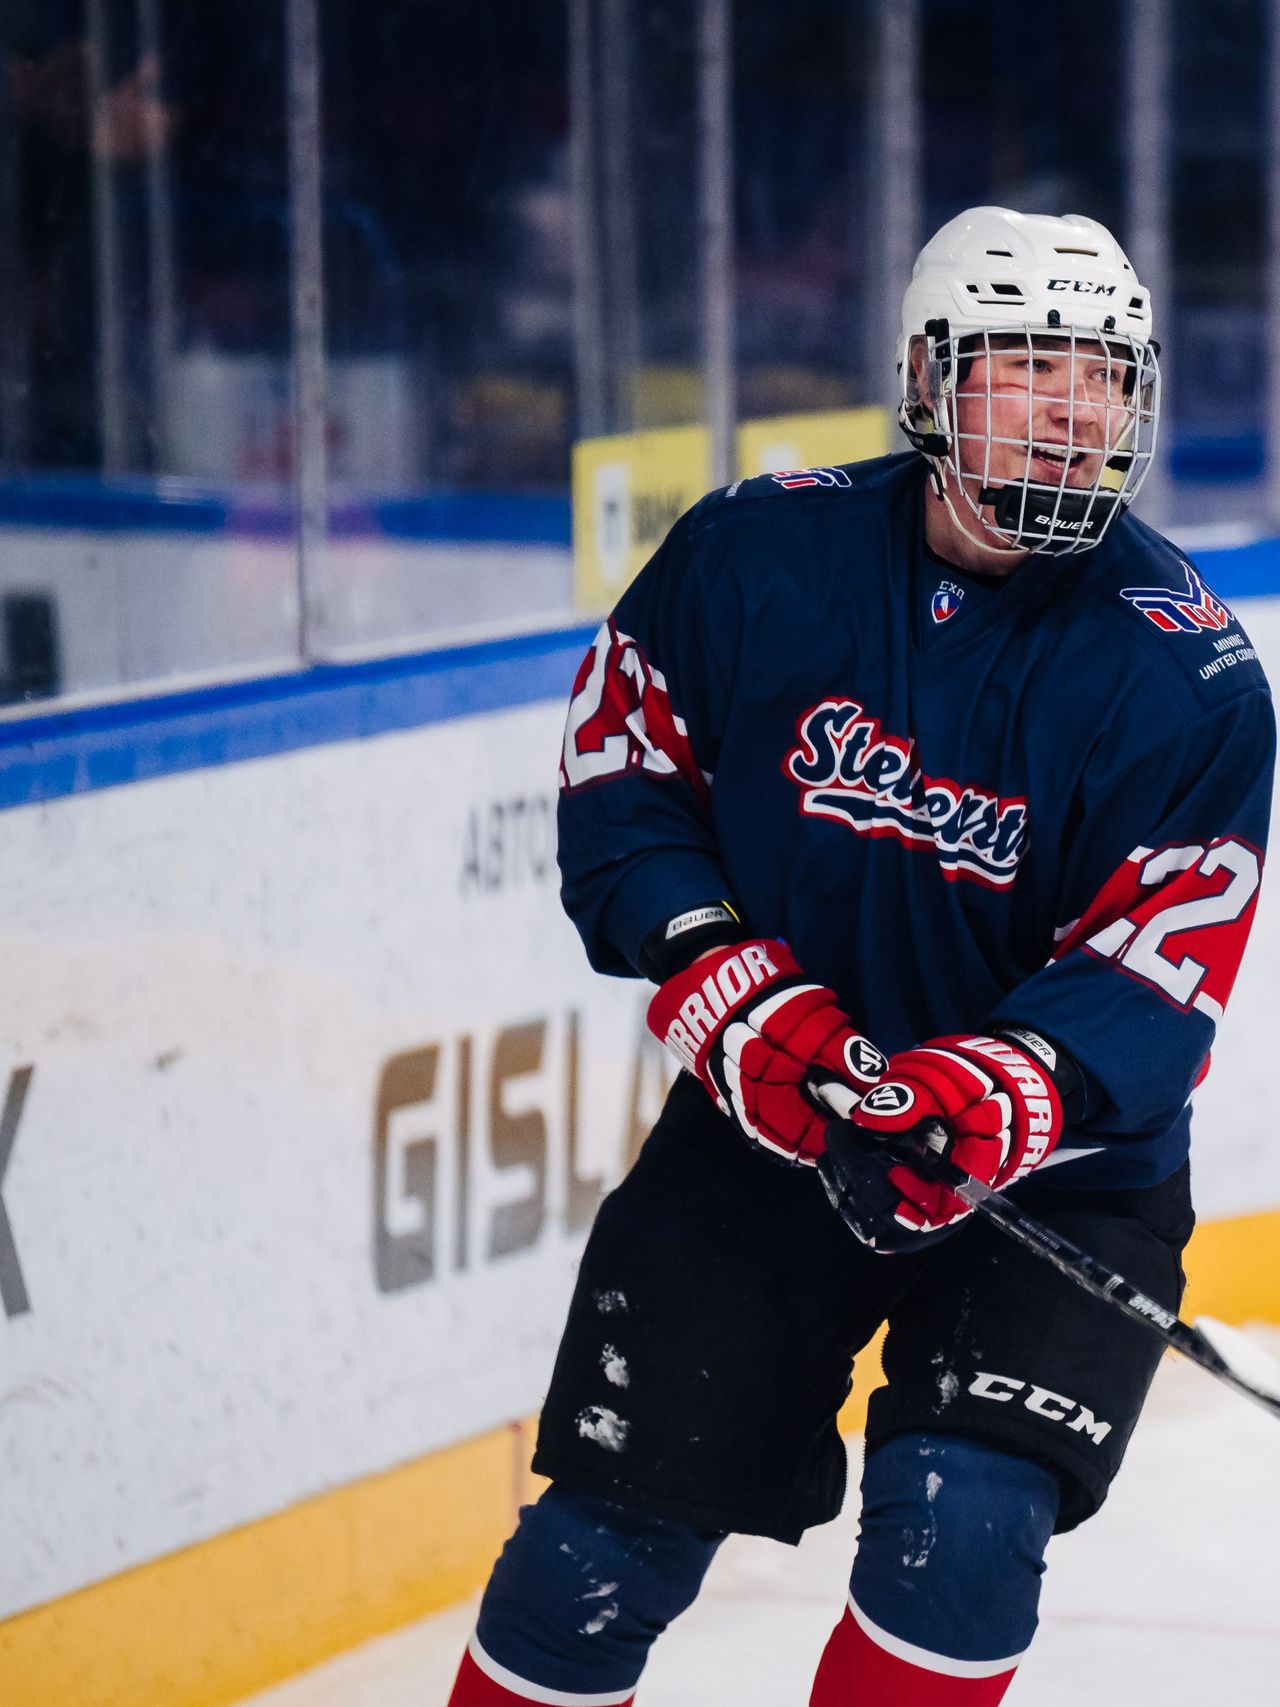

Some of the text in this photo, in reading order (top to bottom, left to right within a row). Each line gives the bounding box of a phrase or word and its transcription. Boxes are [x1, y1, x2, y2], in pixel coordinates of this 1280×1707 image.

[1046, 279, 1117, 297] CCM
[1212, 633, 1245, 653] MINING
[1199, 648, 1259, 680] UNITED COMP
[967, 1371, 1113, 1446] CCM
